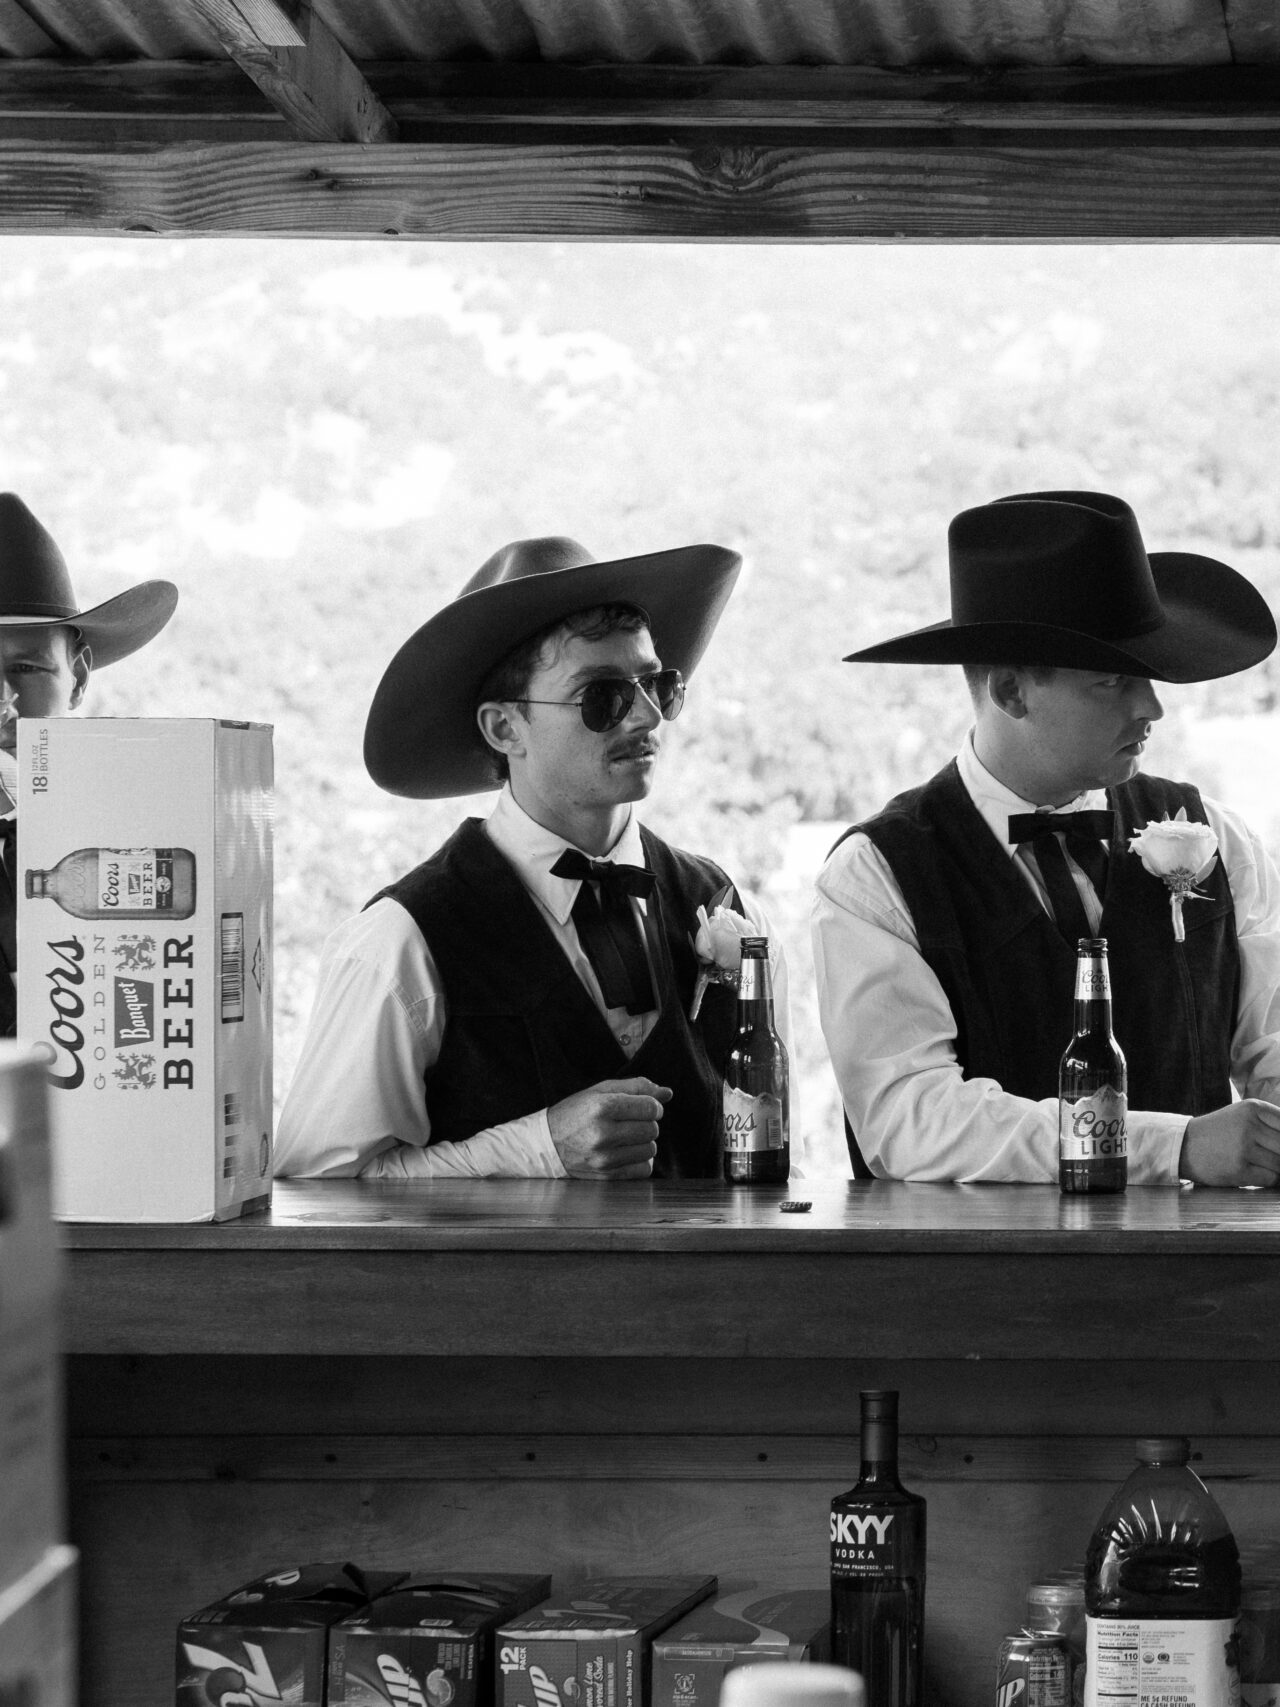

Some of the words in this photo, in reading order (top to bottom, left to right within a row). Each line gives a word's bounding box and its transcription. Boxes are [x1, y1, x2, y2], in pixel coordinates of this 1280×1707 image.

[40, 728, 48, 772] BOTTLES
[32, 775, 48, 795] 18
[101, 862, 120, 908] Coors
[143, 862, 153, 906] BEER
[1081, 969, 1109, 984] Coo
[1085, 984, 1109, 993] LIGH
[93, 933, 106, 1091] GOLDEN
[117, 982, 151, 1039] Banquet
[163, 934, 194, 1091] BEER
[723, 1112, 757, 1132] ors
[1071, 1110, 1127, 1138] Coor
[830, 1512, 894, 1544] SKYY
[835, 1548, 875, 1559] VODKA
[500, 1647, 519, 1674] 12
[593, 1655, 604, 1682] Soda
[625, 1649, 634, 1668] Help
[1123, 1652, 1139, 1661] 110
[377, 1653, 430, 1707] UP
[528, 1665, 563, 1707] UP
[582, 1662, 594, 1685] Lime
[625, 1668, 634, 1697] Holiday
